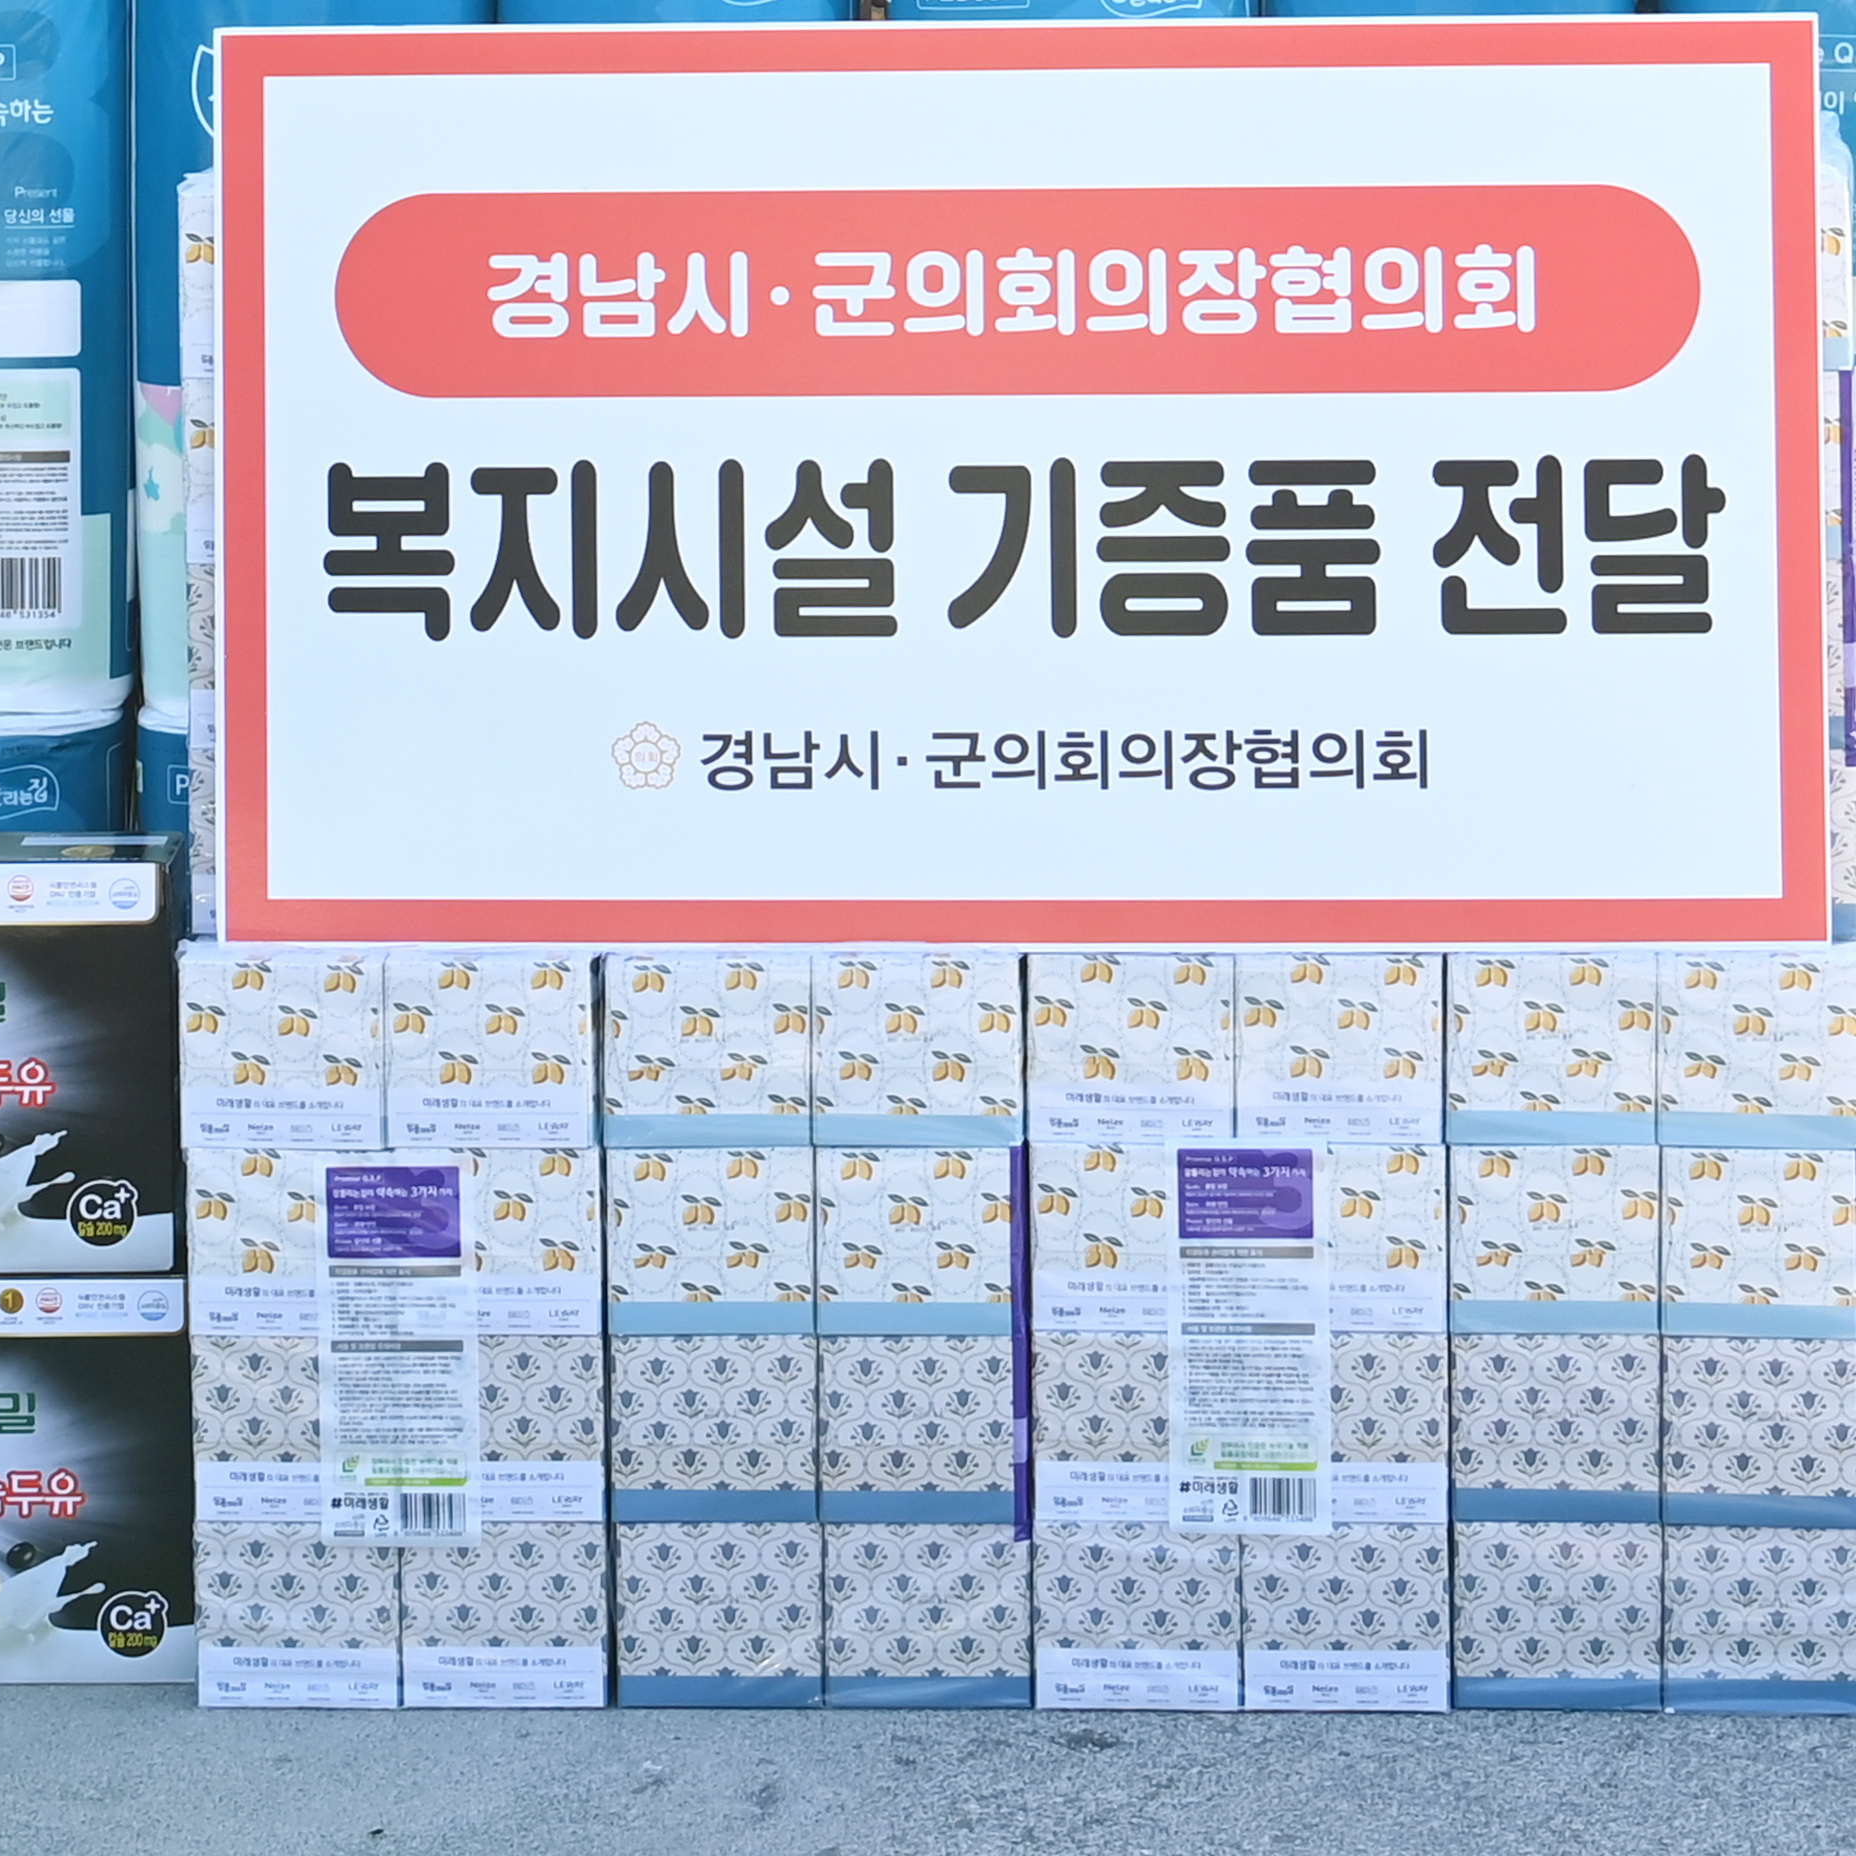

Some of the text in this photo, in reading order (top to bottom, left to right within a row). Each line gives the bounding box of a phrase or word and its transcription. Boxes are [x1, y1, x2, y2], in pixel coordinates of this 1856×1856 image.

[4, 208, 75, 224] 당신의 선물
[488, 245, 1535, 337] 경남시·군의회의장협의회
[324, 459, 897, 641] 복지시설
[948, 458, 1380, 638] 기증품
[1433, 455, 1725, 634] 전달
[702, 730, 1427, 790] 경남시·군의회의장협의회
